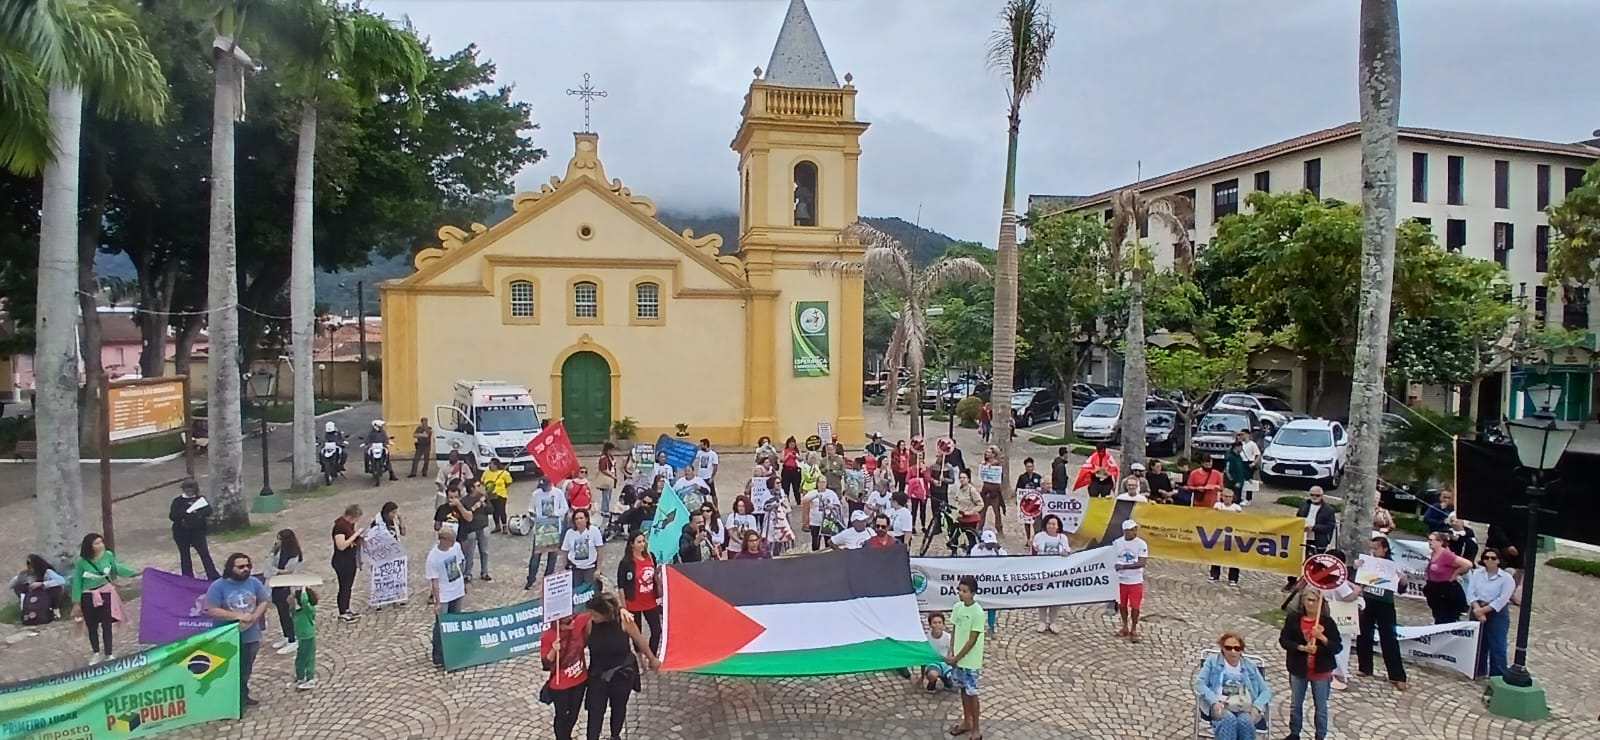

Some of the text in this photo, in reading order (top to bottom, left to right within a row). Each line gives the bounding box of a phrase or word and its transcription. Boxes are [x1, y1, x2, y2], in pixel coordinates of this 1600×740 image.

[1196, 526, 1290, 559] Viva!
[957, 573, 1001, 582] MÓRIA
[1003, 574, 1009, 582] E
[1010, 570, 1068, 582] RESISTÊNCIA
[1070, 567, 1082, 575] DA
[1084, 562, 1106, 573] LUTA
[940, 575, 1110, 596] DA OPULAÇÕES ATINGIDAS
[441, 606, 543, 633] TIRE AS MÃOS DO NOSSO
[480, 632, 499, 645] NÃO
[508, 628, 526, 640] PEC
[104, 684, 185, 715] PLEBISCITO
[2, 717, 46, 736] PRIMEIRO
[106, 700, 186, 731] PPULAR
